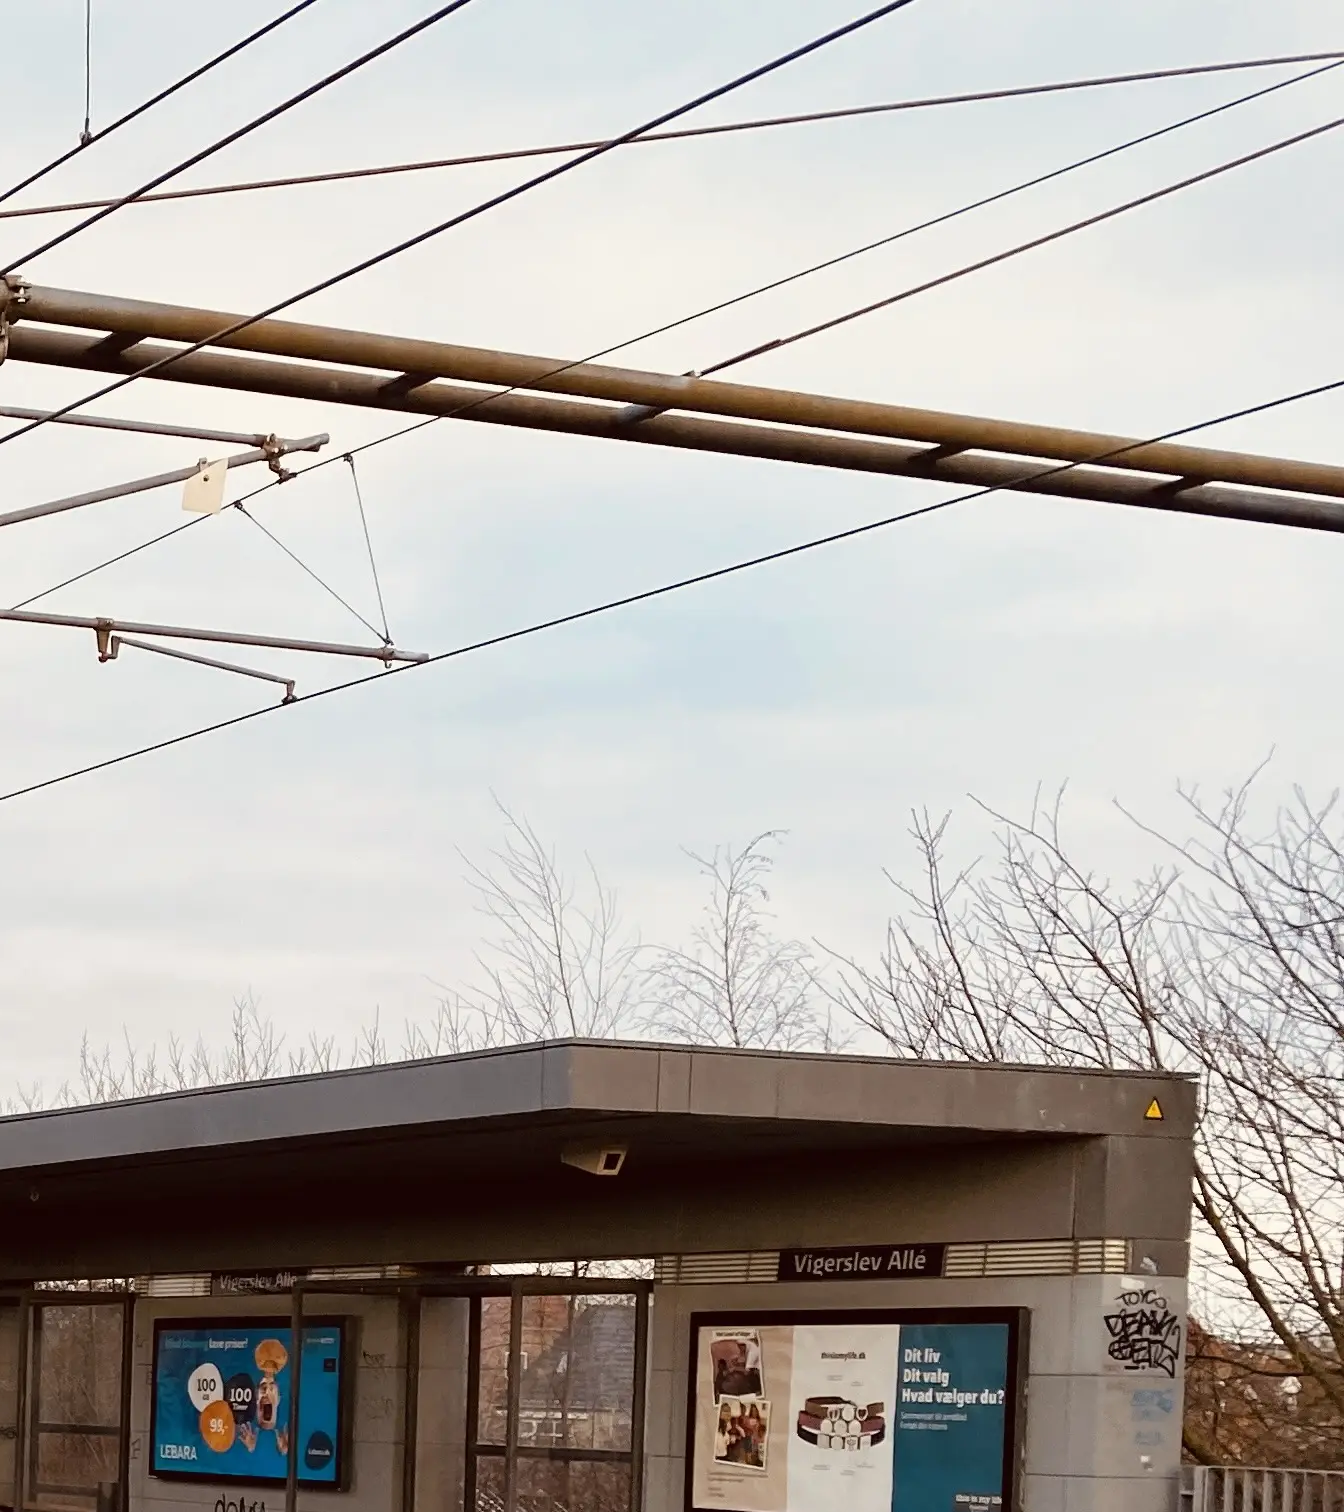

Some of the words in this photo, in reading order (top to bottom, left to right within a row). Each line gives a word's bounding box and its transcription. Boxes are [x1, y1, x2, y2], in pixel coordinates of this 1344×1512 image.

[794, 1251, 882, 1277] Vigerslev
[887, 1248, 927, 1271] Allé
[904, 1347, 922, 1363] Dit
[197, 1378, 217, 1392] 100
[903, 1367, 920, 1383] Dit
[923, 1368, 950, 1387] valg
[229, 1387, 252, 1402] 100
[901, 1388, 933, 1403] Hvad
[935, 1388, 978, 1408] vælger
[980, 1388, 1005, 1405] du?
[160, 1443, 198, 1460] LEBARA
